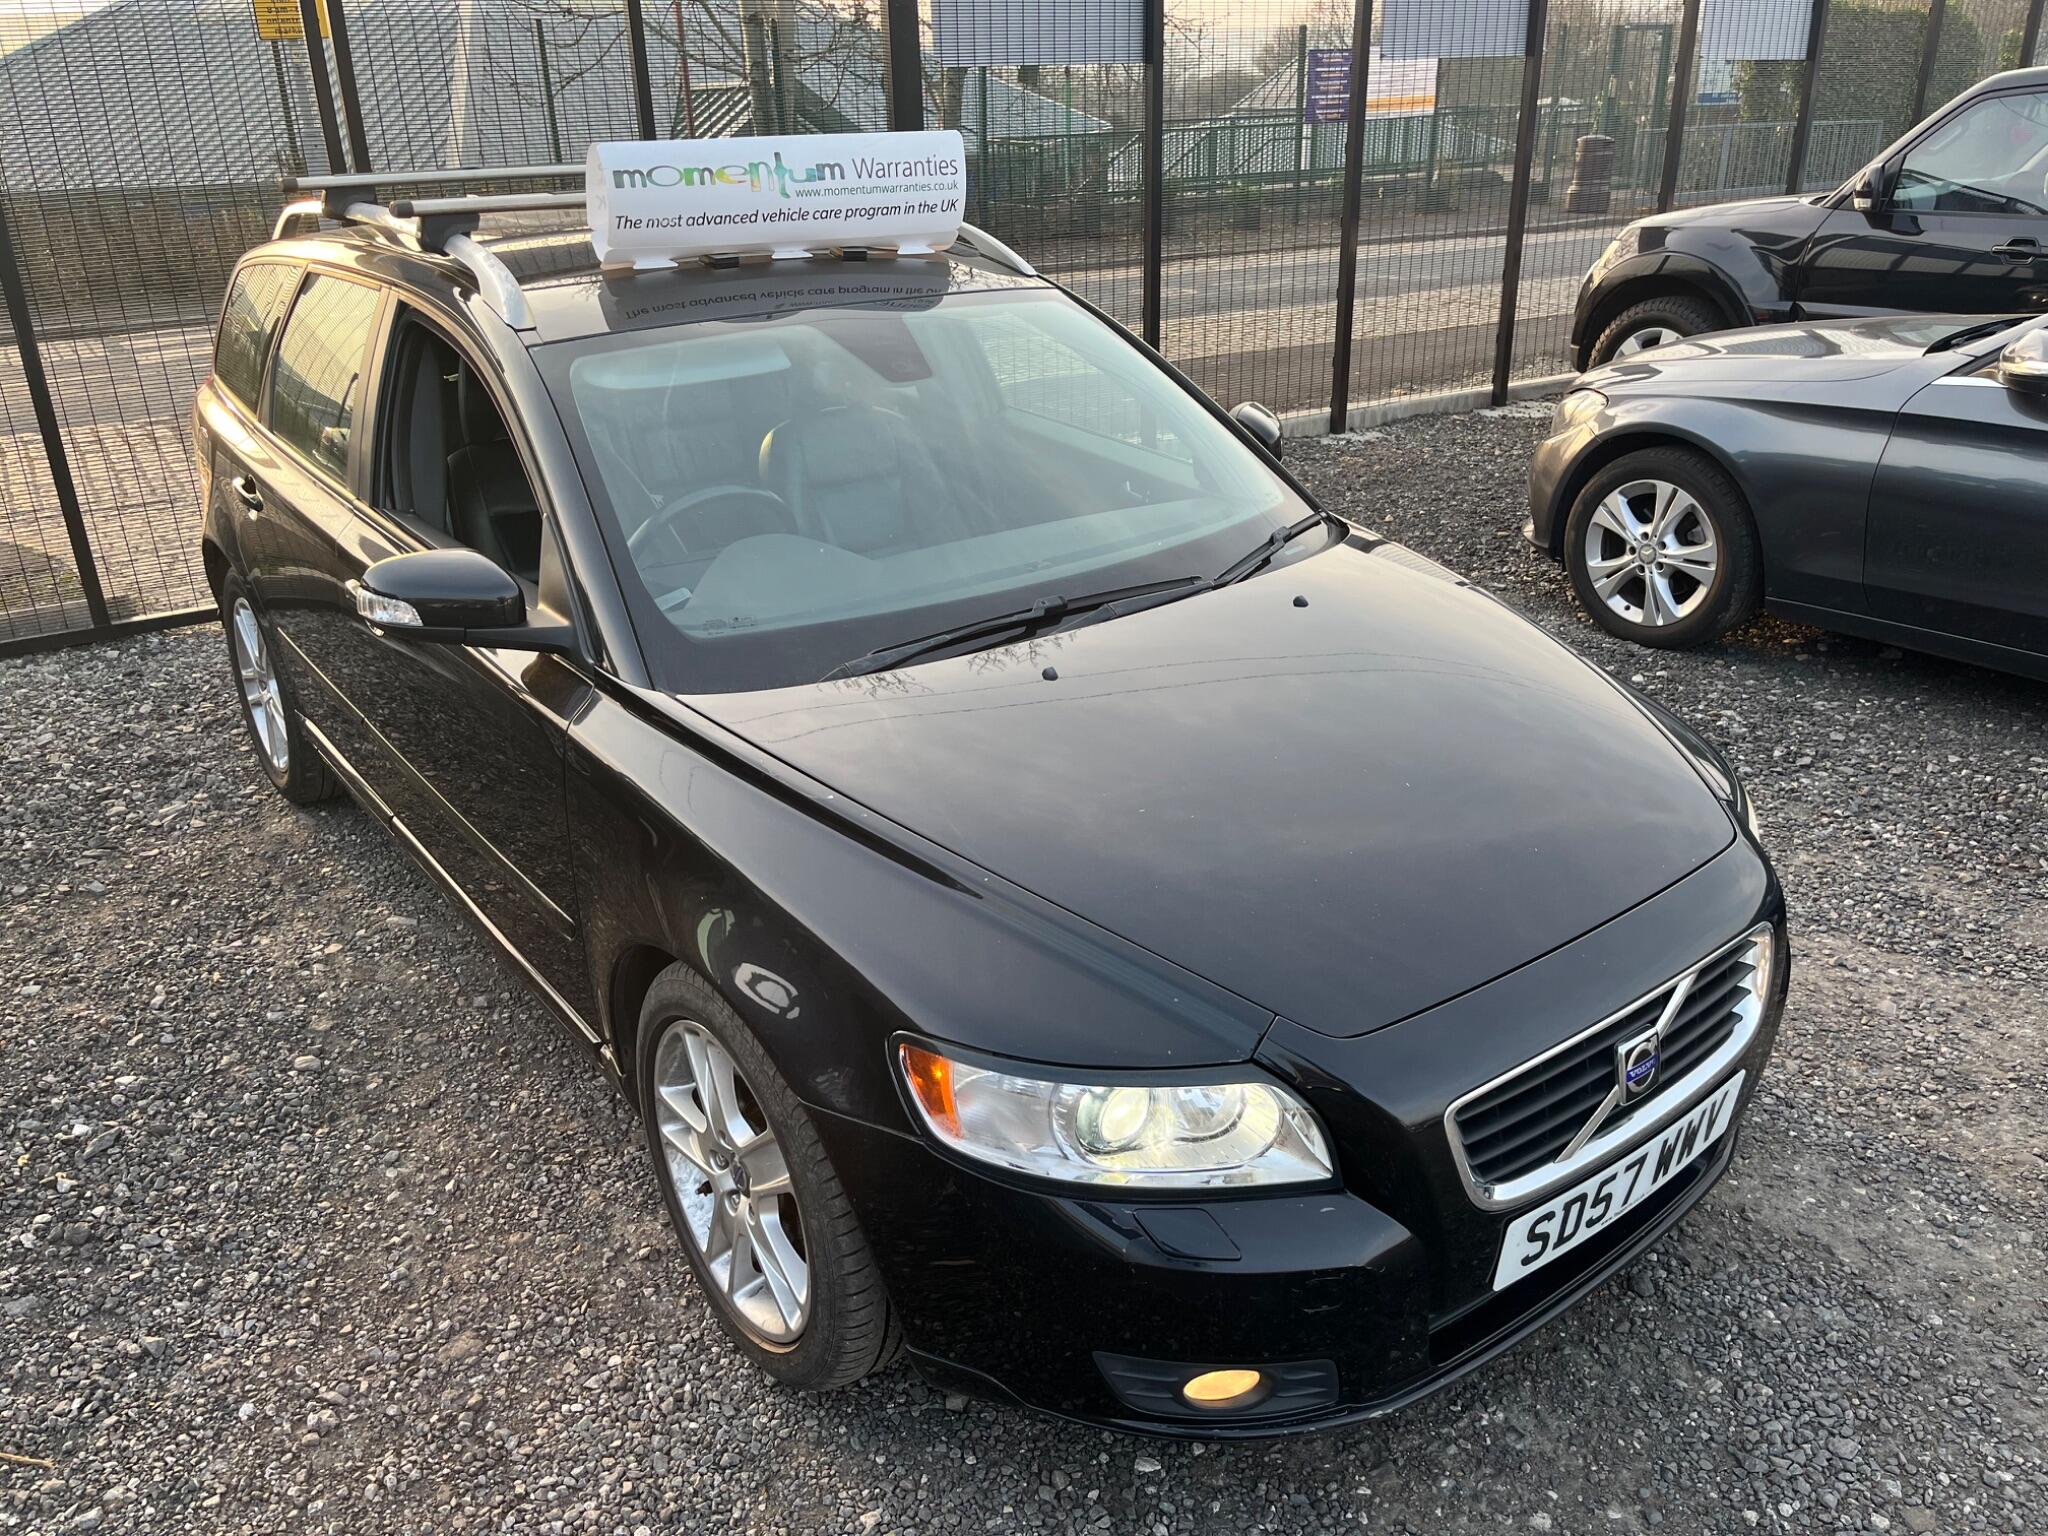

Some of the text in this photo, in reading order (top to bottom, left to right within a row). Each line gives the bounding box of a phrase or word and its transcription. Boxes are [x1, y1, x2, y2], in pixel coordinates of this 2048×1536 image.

[612, 151, 959, 199] momentum Warranties
[795, 180, 959, 198] www.momentumwarranties.co.uk
[615, 198, 959, 230] The most advanced vehicle care program in the UK
[1629, 1057, 1656, 1078] VOLVO
[1520, 1088, 1730, 1267] SD57 WWV
